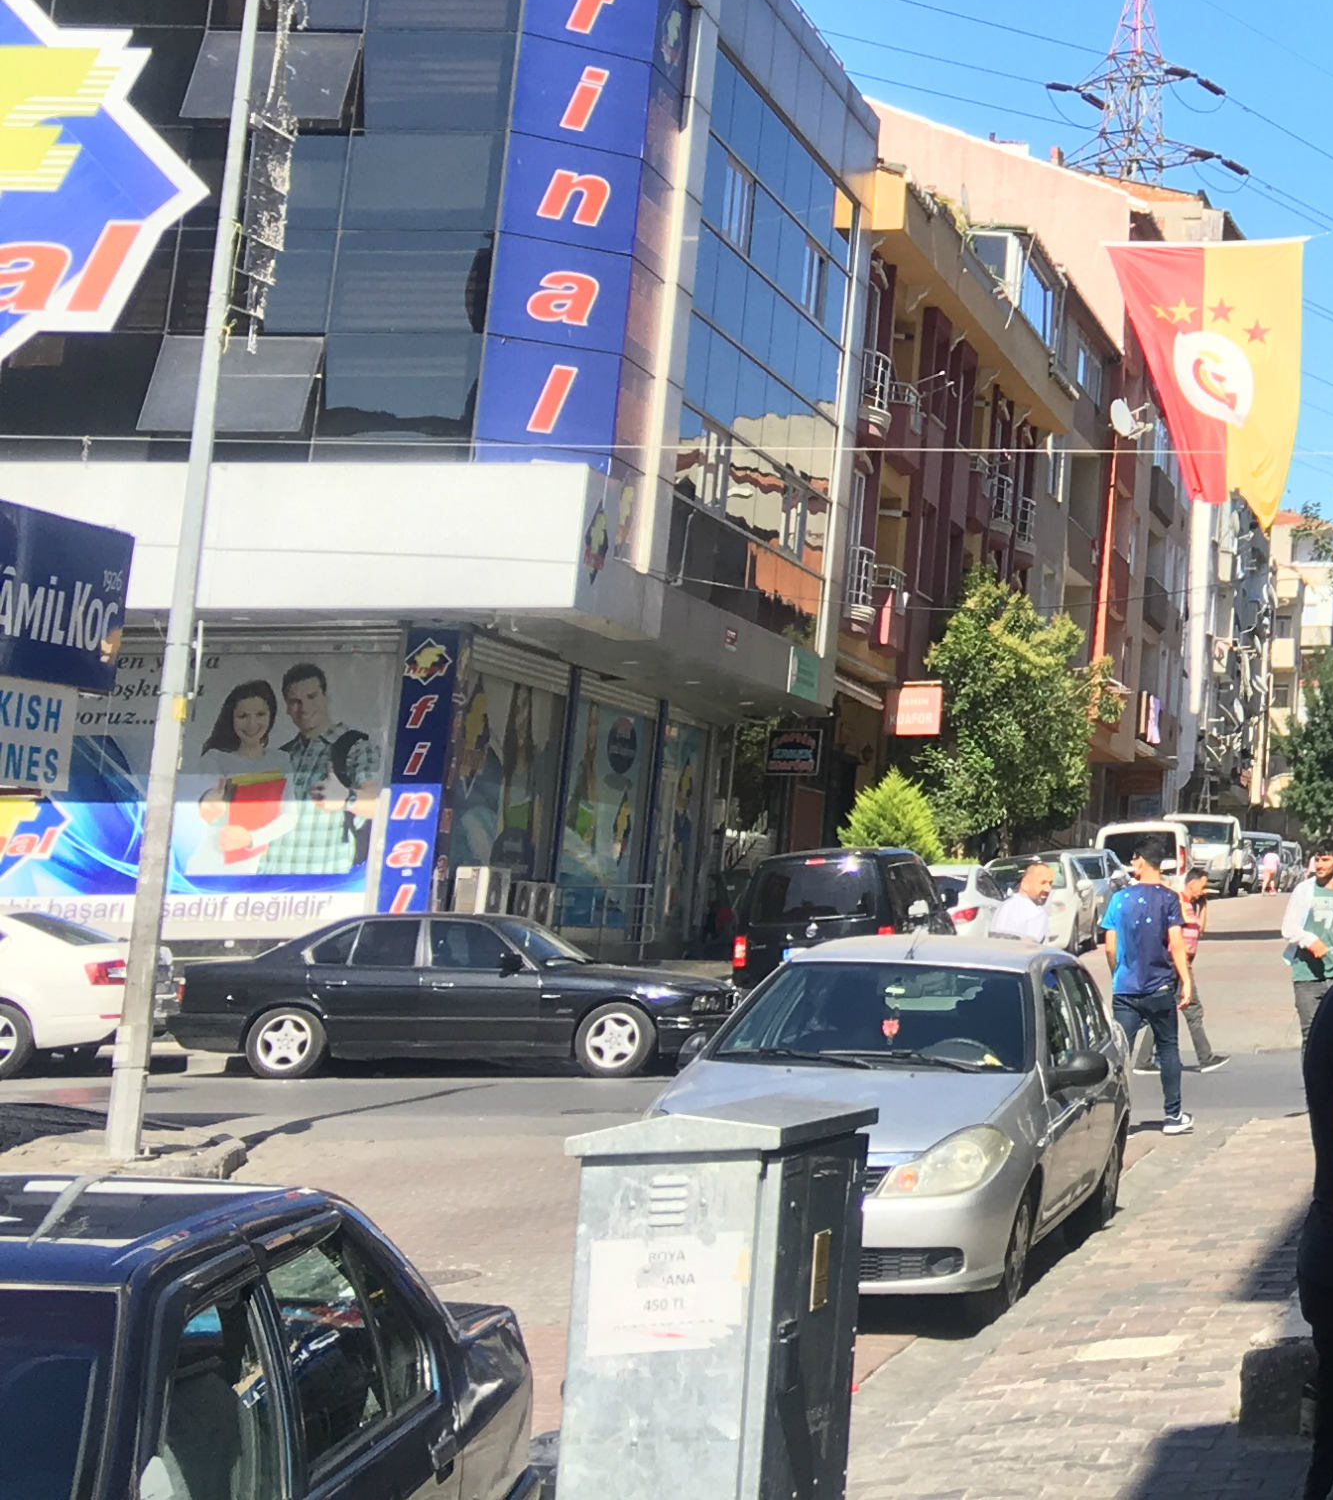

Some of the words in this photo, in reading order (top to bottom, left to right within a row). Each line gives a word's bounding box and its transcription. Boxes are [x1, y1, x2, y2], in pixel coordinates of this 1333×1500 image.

[0, 219, 145, 314] al
[0, 689, 62, 734] KISH
[0, 743, 59, 784] NES
[0, 827, 57, 857] al
[161, 896, 230, 919] sadüf
